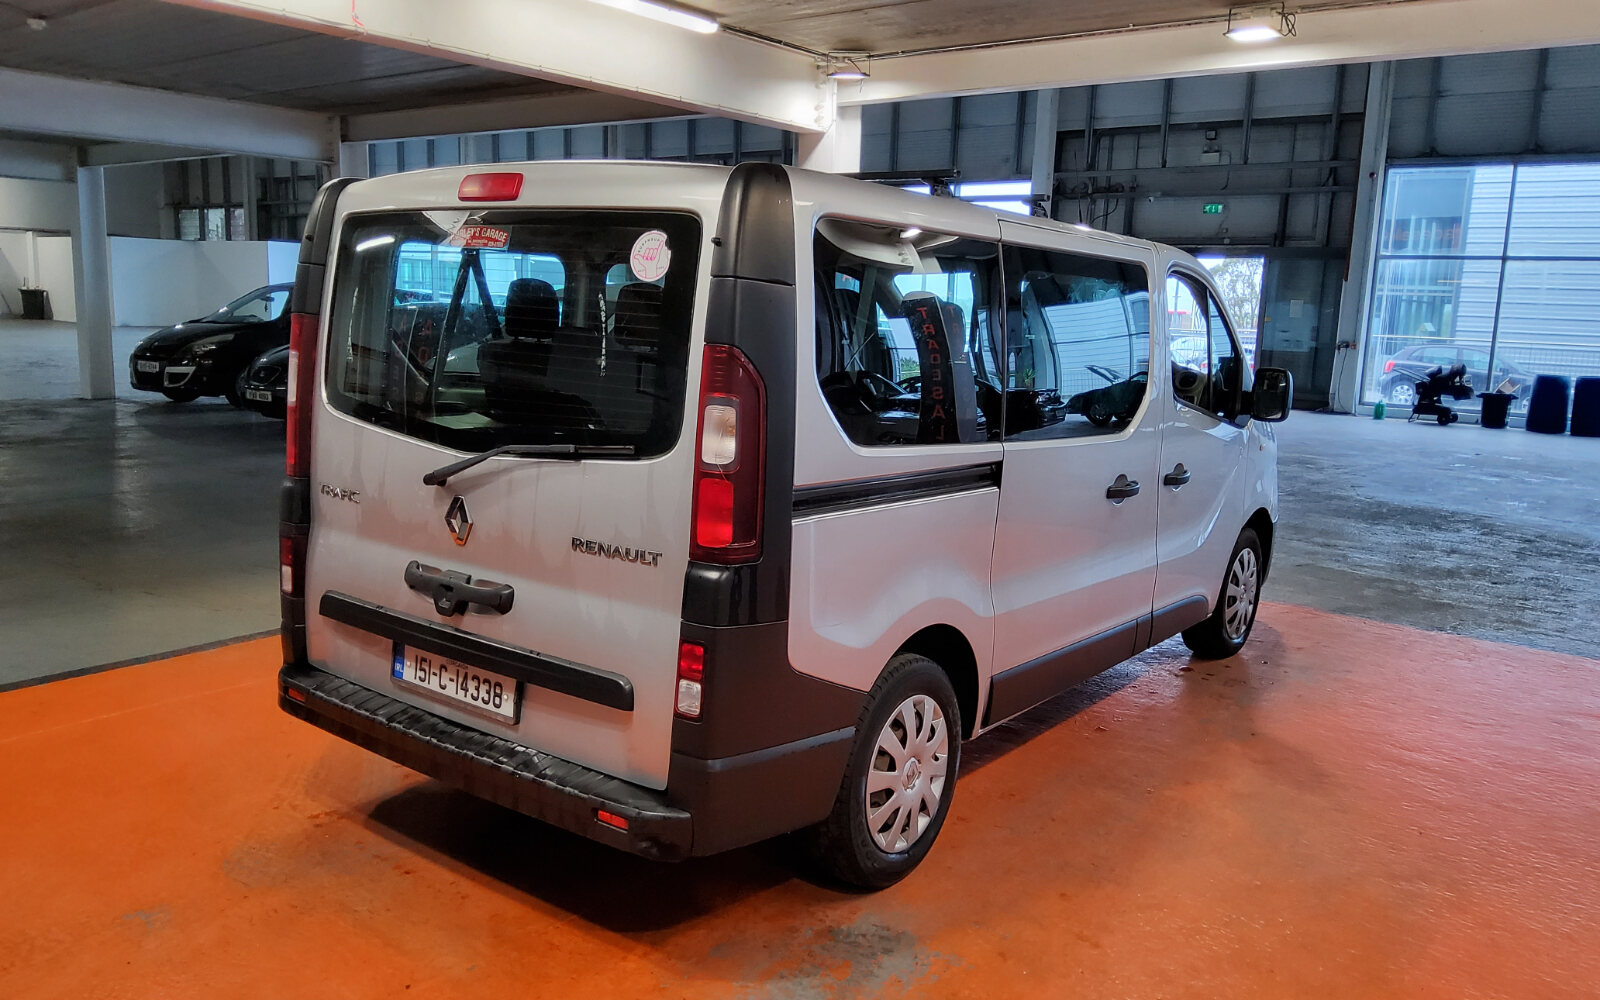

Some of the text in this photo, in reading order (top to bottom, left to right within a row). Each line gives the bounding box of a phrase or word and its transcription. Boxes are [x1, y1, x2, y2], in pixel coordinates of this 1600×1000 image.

[481, 228, 508, 243] GARAGE
[571, 536, 663, 568] RENAULT
[394, 662, 404, 673] IRL
[413, 654, 504, 709] 151-C-14338
